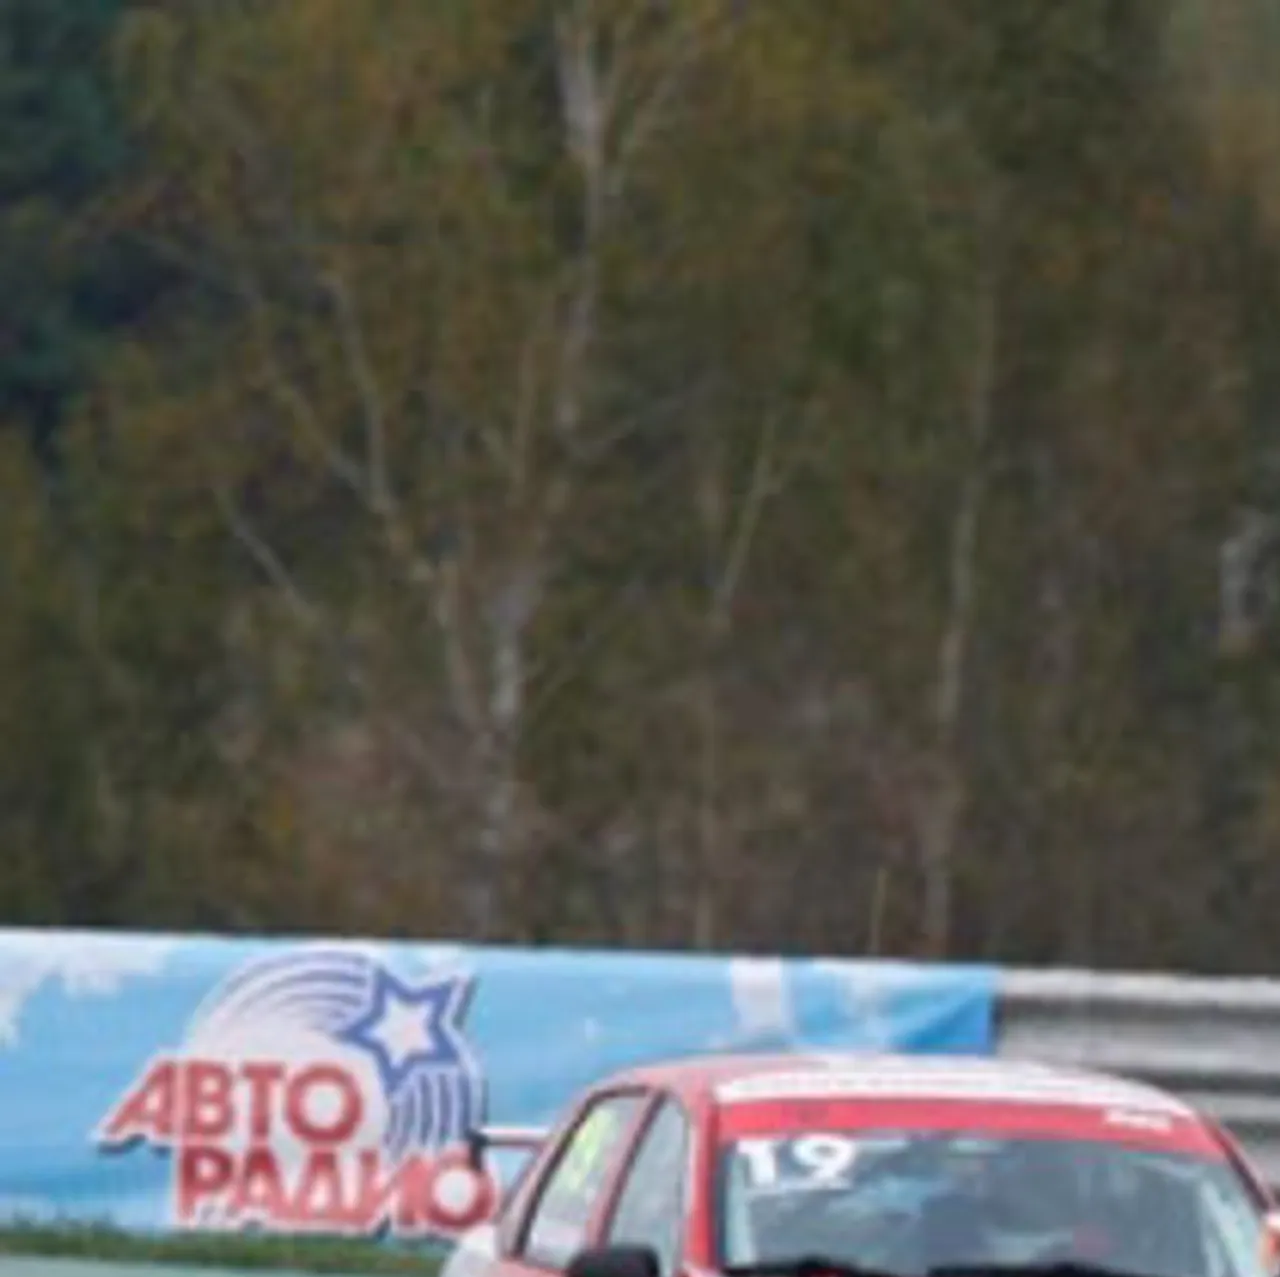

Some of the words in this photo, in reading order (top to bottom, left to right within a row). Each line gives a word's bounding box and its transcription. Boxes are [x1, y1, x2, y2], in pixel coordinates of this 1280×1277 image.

[102, 1060, 365, 1145] АВТО
[176, 1145, 497, 1230] РАДИО
[736, 1135, 860, 1188] 19
